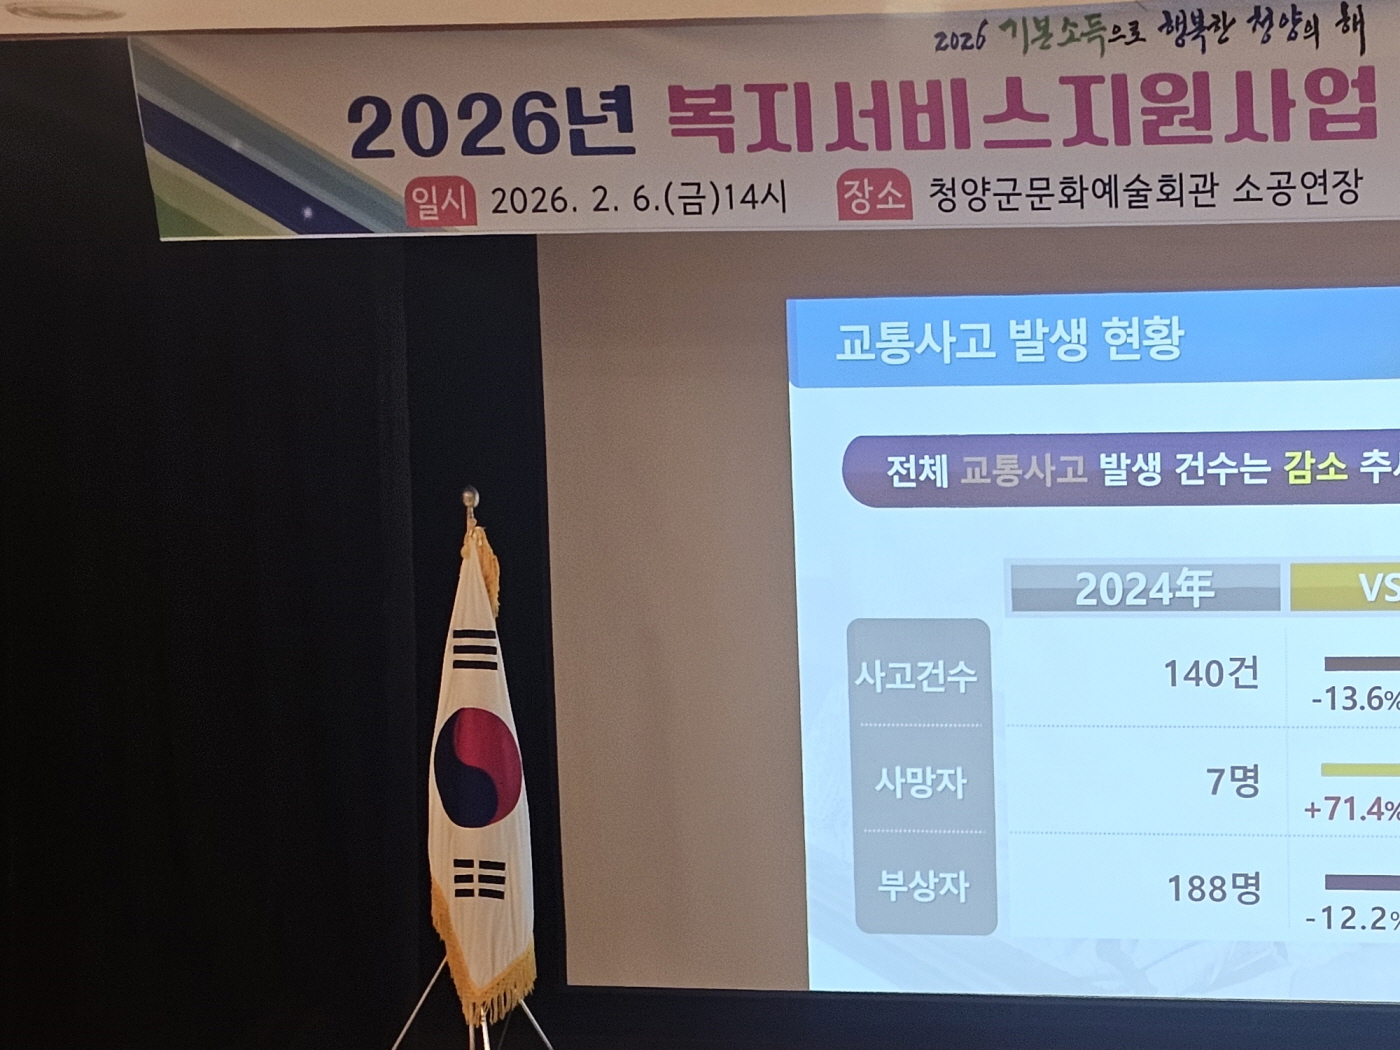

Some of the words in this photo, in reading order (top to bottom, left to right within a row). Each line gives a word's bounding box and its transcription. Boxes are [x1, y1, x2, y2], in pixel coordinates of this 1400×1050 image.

[934, 19, 989, 52] 2026
[1000, 12, 1146, 58] 기본소득으로
[1157, 8, 1237, 55] 행복한
[1247, 3, 1319, 49] 청양의
[1335, 1, 1367, 56] 해
[347, 84, 637, 159] 2026년
[667, 65, 1378, 154] 복지서비스지원사업
[411, 183, 467, 221] 일시
[491, 186, 578, 215] 2026.
[591, 185, 619, 213] 2.
[632, 178, 788, 216] 6.(금)14시
[843, 178, 907, 213] 장소
[930, 171, 1220, 214] 청양군문화예술회관
[1232, 167, 1364, 206] 소공연장
[835, 318, 997, 366] 교통사고
[1008, 316, 1089, 363] 발생
[1101, 314, 1185, 361] 현황
[886, 453, 949, 489] 전체
[960, 453, 1088, 489] 교통사고
[1099, 451, 1163, 487] 발생
[1174, 450, 1272, 486] 건수는
[1283, 449, 1348, 484] 감소
[1074, 567, 1216, 609] 2024年
[854, 659, 979, 694] 사고건수
[1164, 654, 1260, 691] 140건
[874, 765, 968, 800] 사망자
[1206, 762, 1261, 799] 7명
[877, 869, 970, 904] 부상자
[1167, 871, 1262, 906] 188명
